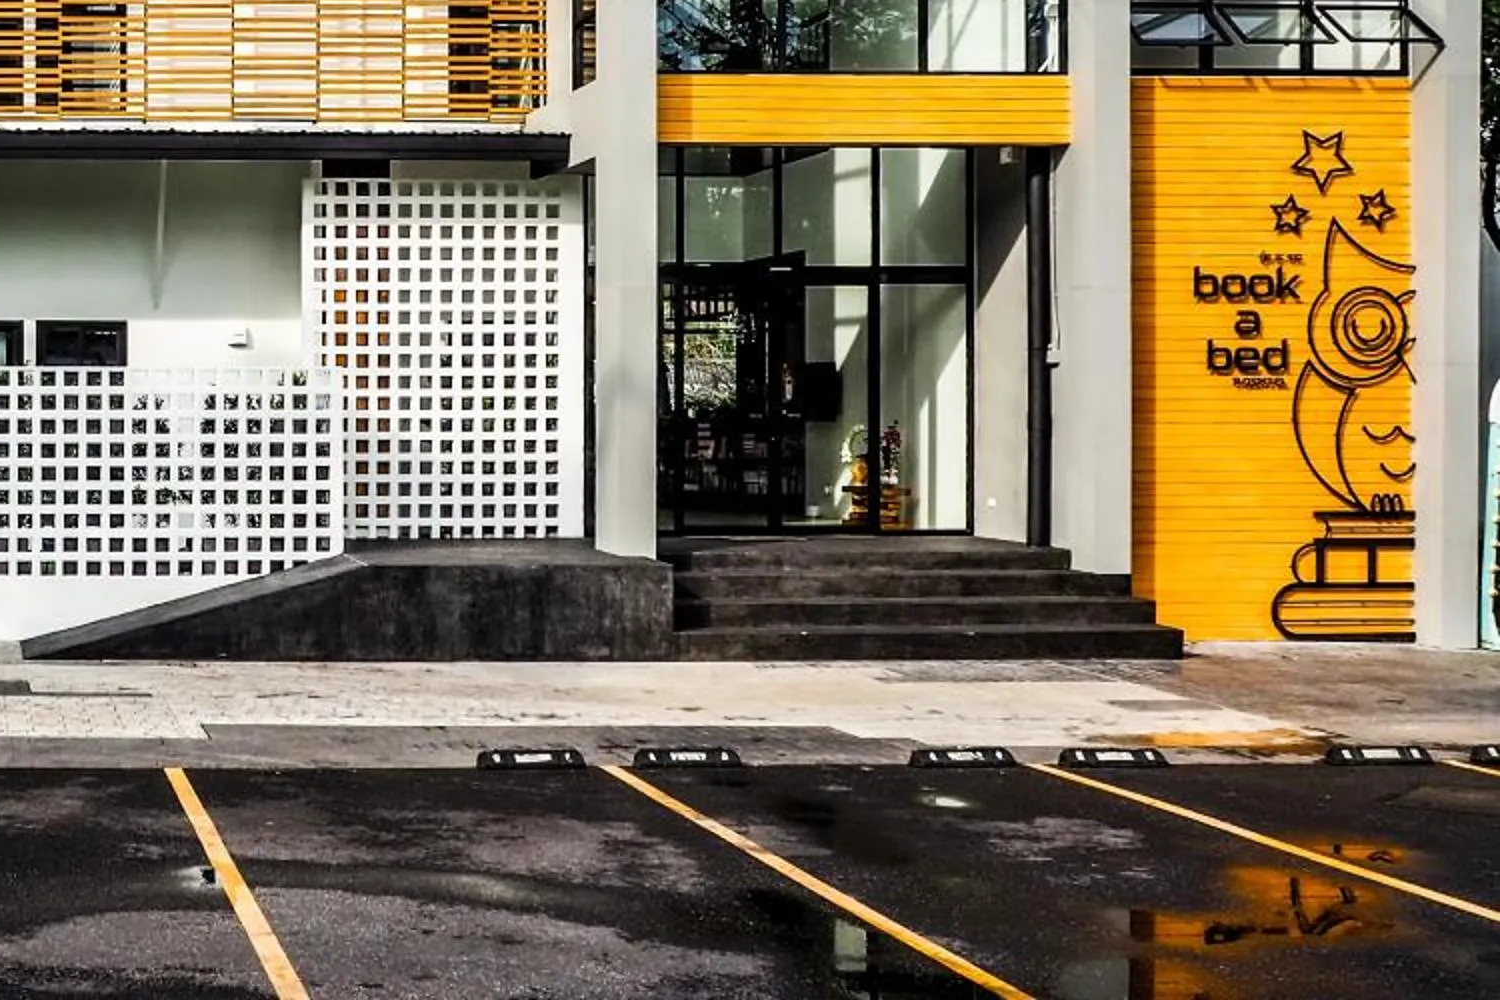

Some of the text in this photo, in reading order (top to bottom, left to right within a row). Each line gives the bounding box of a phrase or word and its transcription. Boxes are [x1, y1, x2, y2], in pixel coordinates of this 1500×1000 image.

[1193, 265, 1301, 300] book
[1234, 310, 1261, 337] a
[1207, 338, 1288, 373] bed
